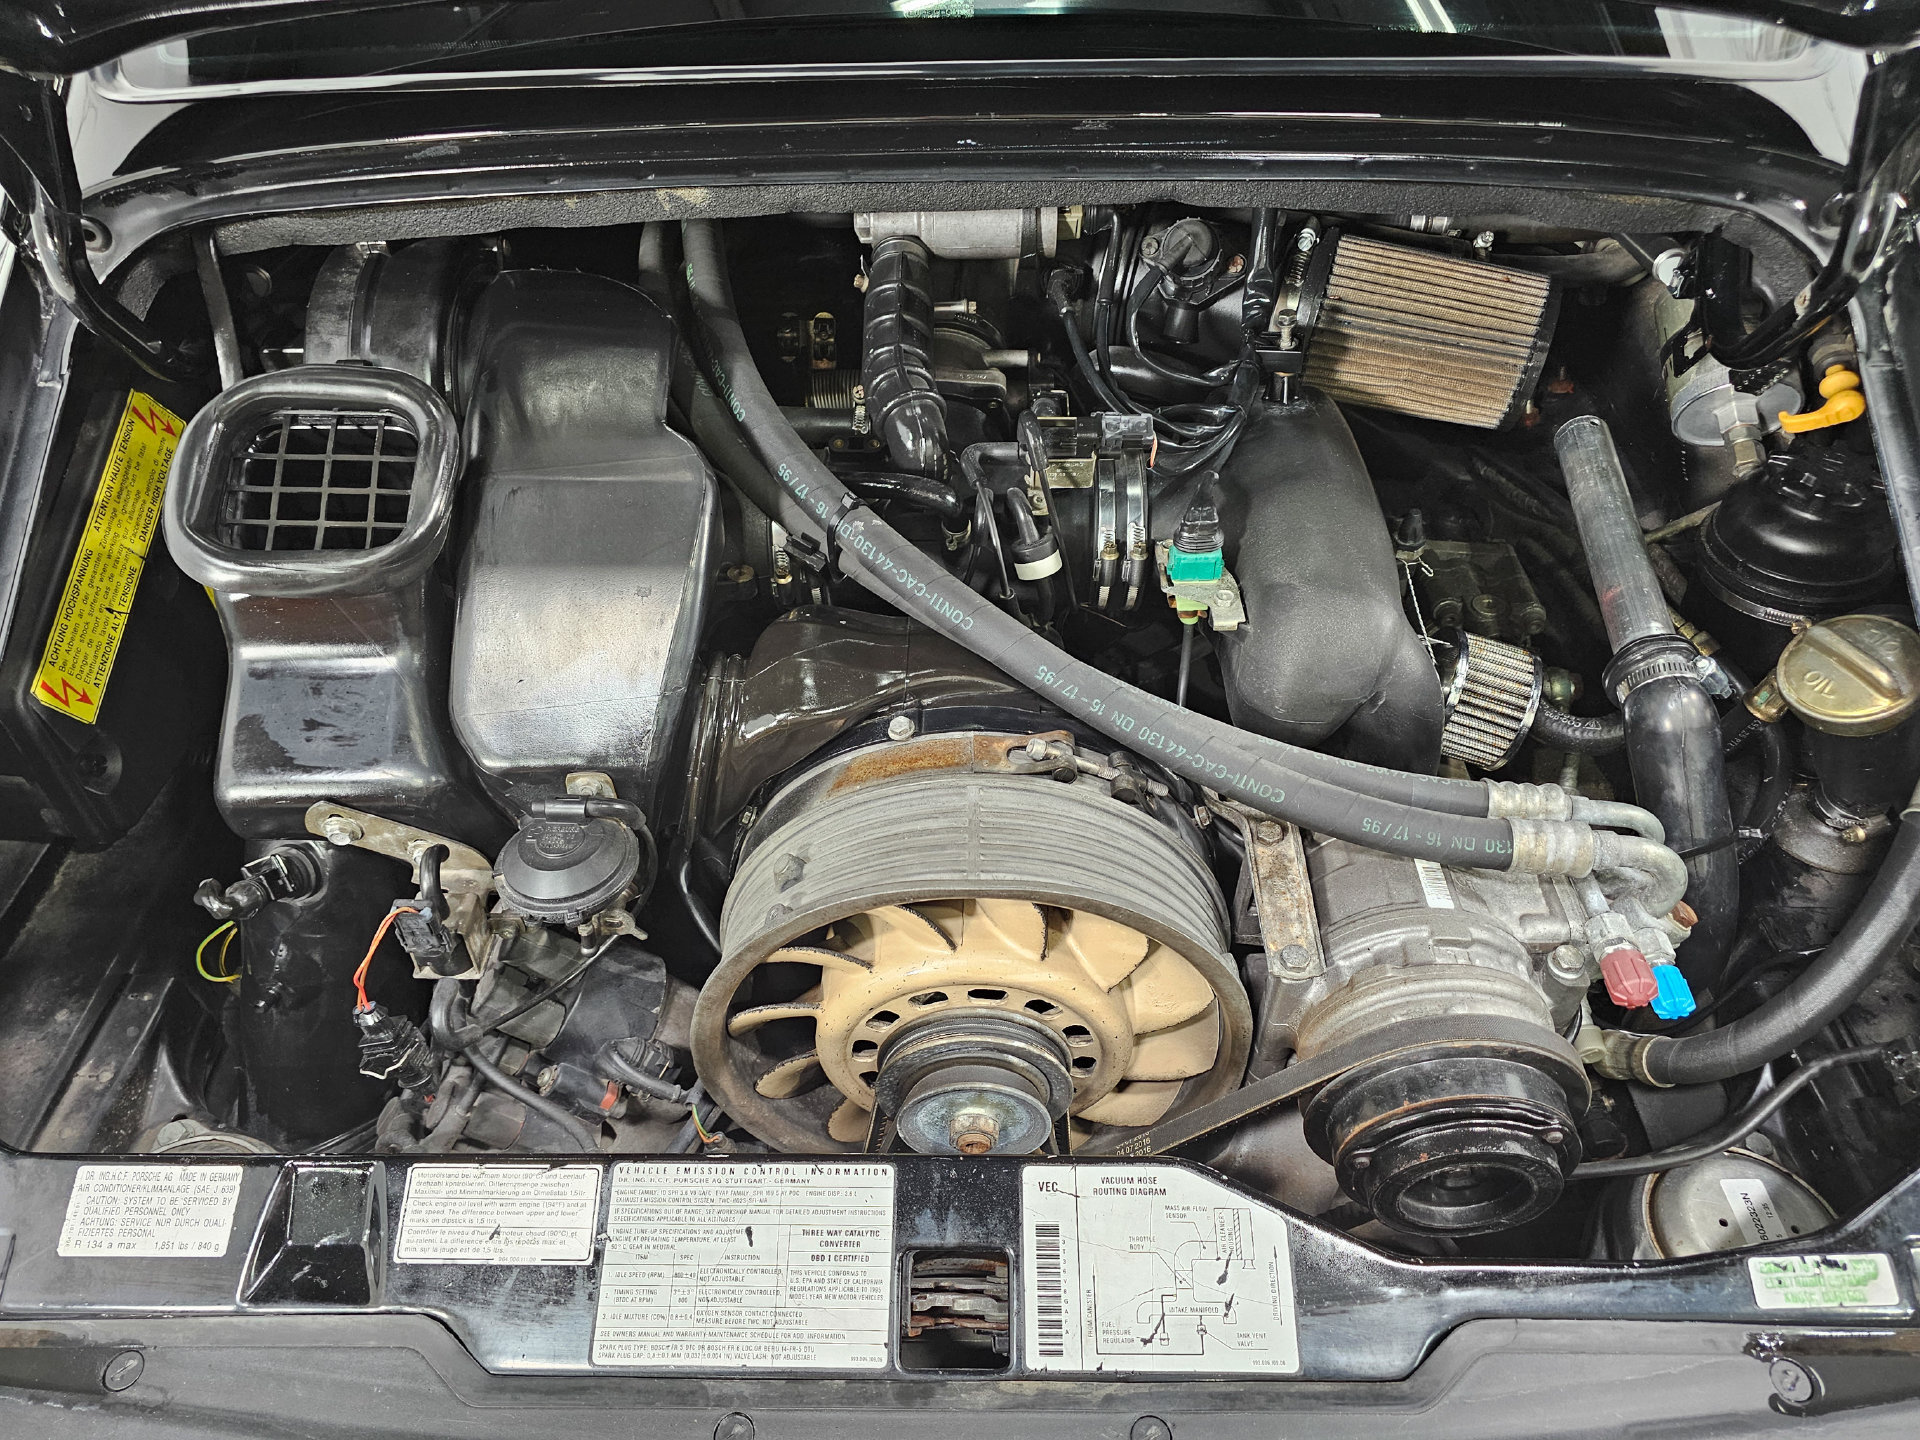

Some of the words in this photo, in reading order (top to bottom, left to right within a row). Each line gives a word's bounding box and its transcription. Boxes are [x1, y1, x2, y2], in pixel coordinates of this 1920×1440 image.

[94, 484, 114, 532] ATTENTION
[109, 455, 124, 484] HAUTE
[118, 418, 135, 454] TENSION
[138, 507, 155, 543] DANGER
[150, 485, 162, 507] HIGH
[156, 447, 173, 484] VOLTAGE
[815, 501, 829, 519] 16
[58, 659, 68, 672] Bei
[65, 622, 80, 655] Arbeiten
[78, 608, 85, 619] an
[82, 592, 90, 605] der
[87, 552, 103, 589] gesamten
[113, 457, 133, 504] Lebensgefahr
[67, 647, 81, 676] Electric
[79, 622, 90, 643] shock
[87, 586, 101, 617] suffered
[99, 563, 109, 583] when
[106, 532, 119, 560] working
[116, 518, 123, 528] on
[121, 490, 132, 515] ignition
[129, 473, 137, 487] can
[134, 461, 140, 471] be
[137, 442, 146, 459] fatal
[83, 640, 103, 685] Effettuando
[99, 616, 110, 637] lavori
[130, 499, 147, 544] d'accensione
[144, 468, 156, 497] pericolo
[157, 437, 166, 456] morte
[48, 623, 68, 667] ACHTUNG
[63, 548, 93, 622] HOCHSPANNUNG
[75, 652, 89, 680] Danger
[87, 638, 94, 648] de
[91, 616, 101, 634] mort
[99, 603, 106, 613] en
[103, 586, 111, 600] cas
[108, 573, 114, 583] de
[93, 633, 116, 689] ATTENZIONE
[111, 610, 125, 633] ALTA
[118, 566, 137, 607] TENSIONE
[1804, 671, 1835, 699] OIL
[1089, 699, 1106, 717] 16
[1111, 710, 1136, 732] DN
[1138, 726, 1286, 804] CONTI-CAC-44130
[1426, 831, 1442, 847] 16
[1451, 835, 1476, 851] DN
[1134, 1137, 1151, 1150] 2016
[132, 1172, 161, 1181] PORSCHE
[164, 1172, 173, 1181] AG
[179, 1172, 197, 1181] MADE
[200, 1172, 207, 1181] IN
[210, 1172, 240, 1181] GERMANY
[676, 1167, 735, 1175] EMISSION
[743, 1167, 796, 1175] CONTROL
[805, 1167, 888, 1176] INFORMATION
[1038, 1181, 1058, 1192] VEC
[1100, 1176, 1134, 1185] VACUUM
[1137, 1176, 1158, 1185] HOSE
[78, 1184, 90, 1192] AIR
[1093, 1187, 1127, 1196] ROUTING
[1130, 1187, 1167, 1196] DIAGRAM
[124, 1197, 152, 1205] SYSTEM
[157, 1197, 166, 1205] TO
[170, 1197, 179, 1205] BE
[183, 1197, 218, 1205] SERVICED
[84, 1207, 120, 1215] QUALIFIED
[124, 1207, 166, 1215] PERSONNEL
[172, 1208, 190, 1216] ONLY
[121, 1218, 152, 1226] SERVICE
[156, 1218, 171, 1226] NUR
[175, 1218, 200, 1227] DURCH
[78, 1228, 114, 1236] FIZIERTES
[118, 1228, 155, 1237] PERSONAL
[802, 1229, 824, 1237] THREE
[826, 1229, 842, 1237] WAY
[844, 1229, 880, 1237] CATALYTIC
[74, 1240, 82, 1248] R
[87, 1240, 102, 1248] 134
[178, 1242, 188, 1250] lbs
[198, 1242, 212, 1250] 840
[214, 1244, 219, 1252] g
[819, 1240, 861, 1248] CONVERTER
[1168, 1306, 1188, 1314] INTAKE
[1190, 1306, 1219, 1314] MANIFOLD
